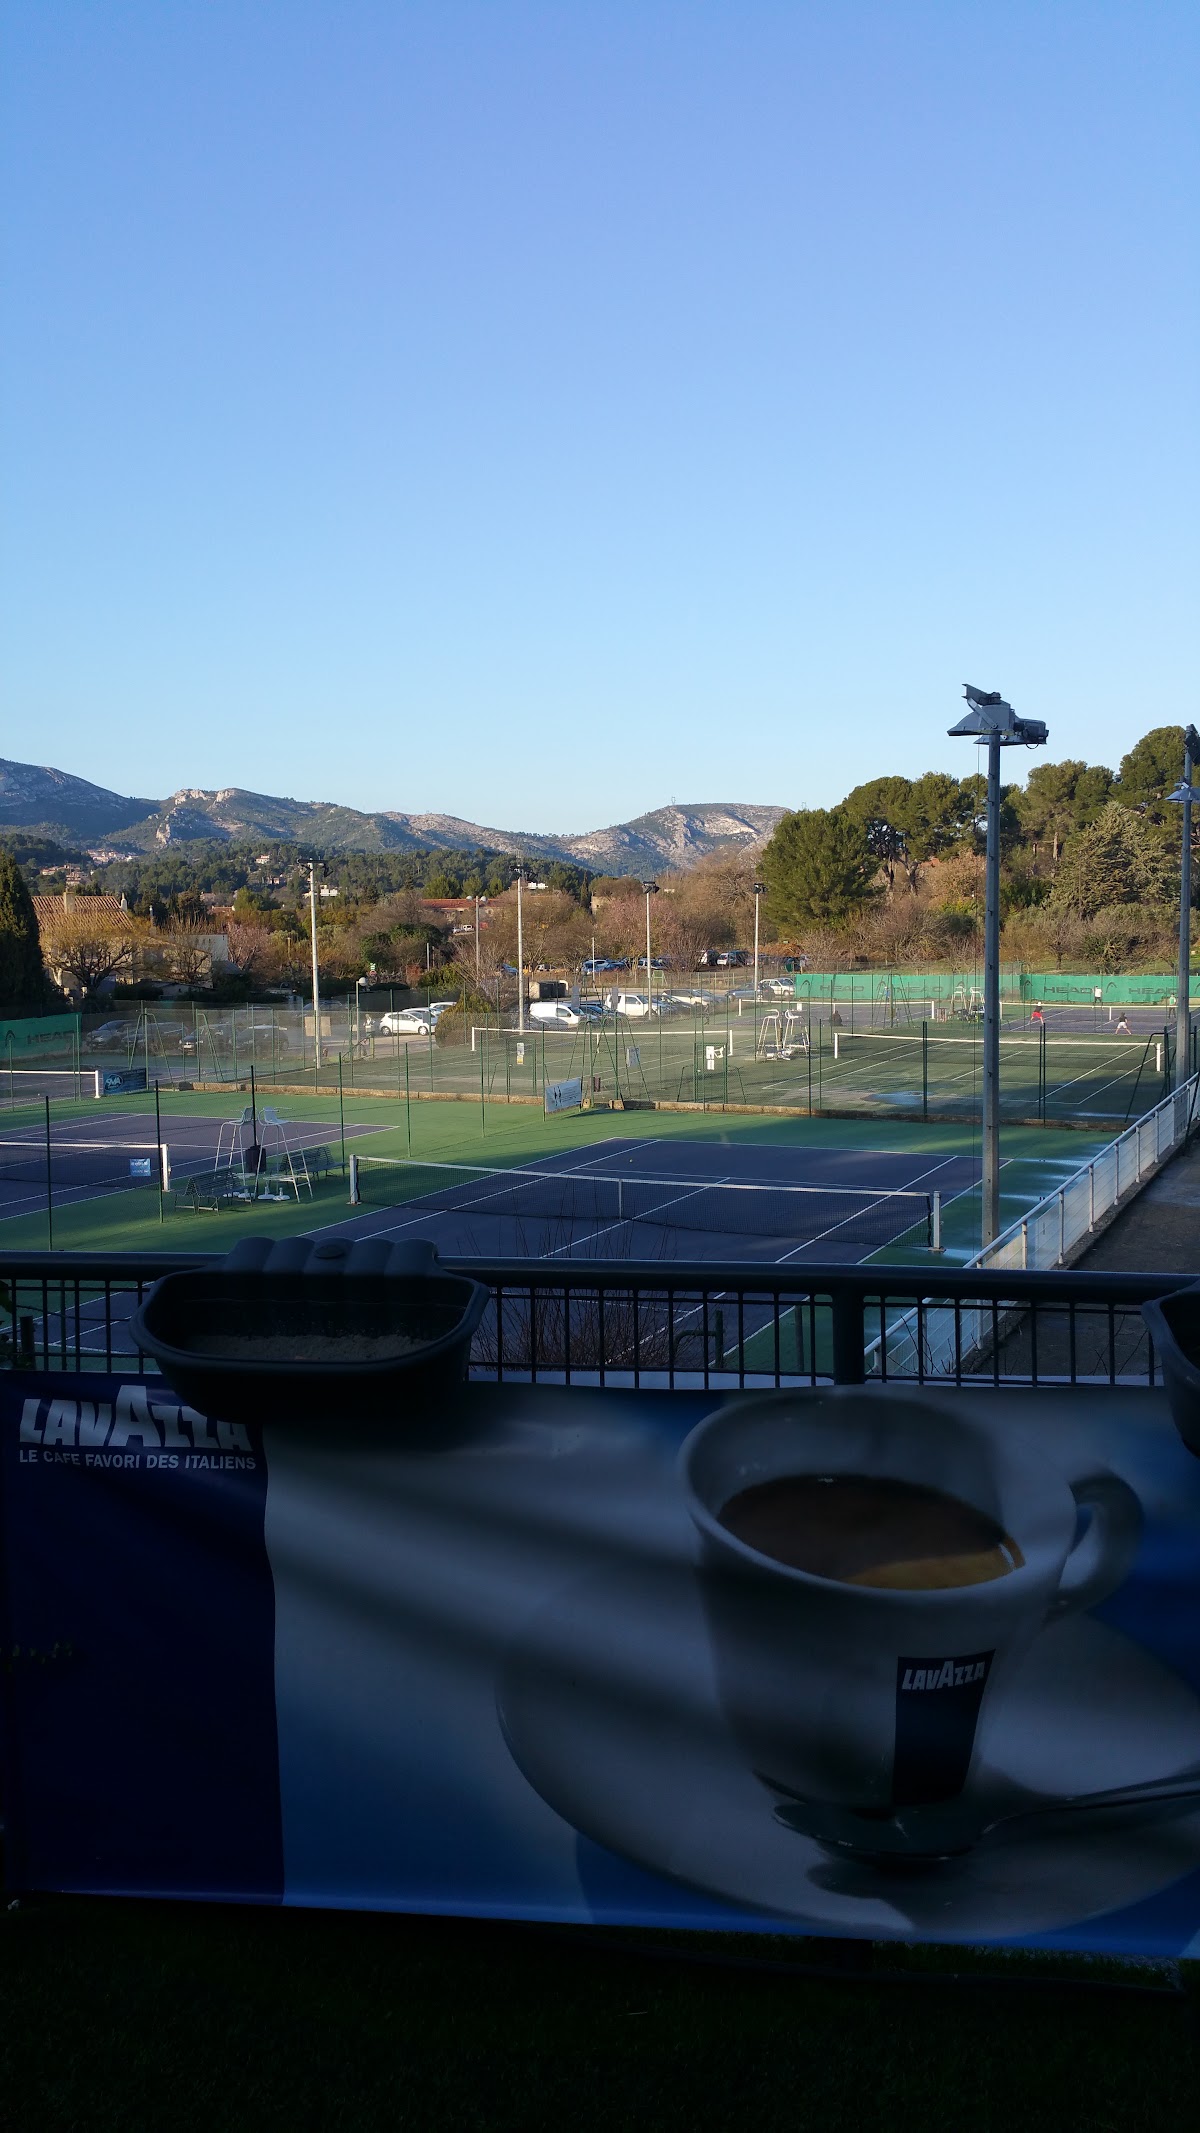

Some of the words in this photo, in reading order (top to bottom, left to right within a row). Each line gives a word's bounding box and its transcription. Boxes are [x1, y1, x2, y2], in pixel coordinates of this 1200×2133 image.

[1044, 986, 1093, 994] HEAD
[20, 1385, 253, 1451] LAVAZZA
[19, 1450, 38, 1463] LE
[43, 1451, 80, 1466] CAFE
[85, 1453, 140, 1468] FAVORI
[146, 1455, 179, 1469] DES
[185, 1455, 257, 1470] ITALIENS
[902, 1660, 985, 1690] LAVAZZA
